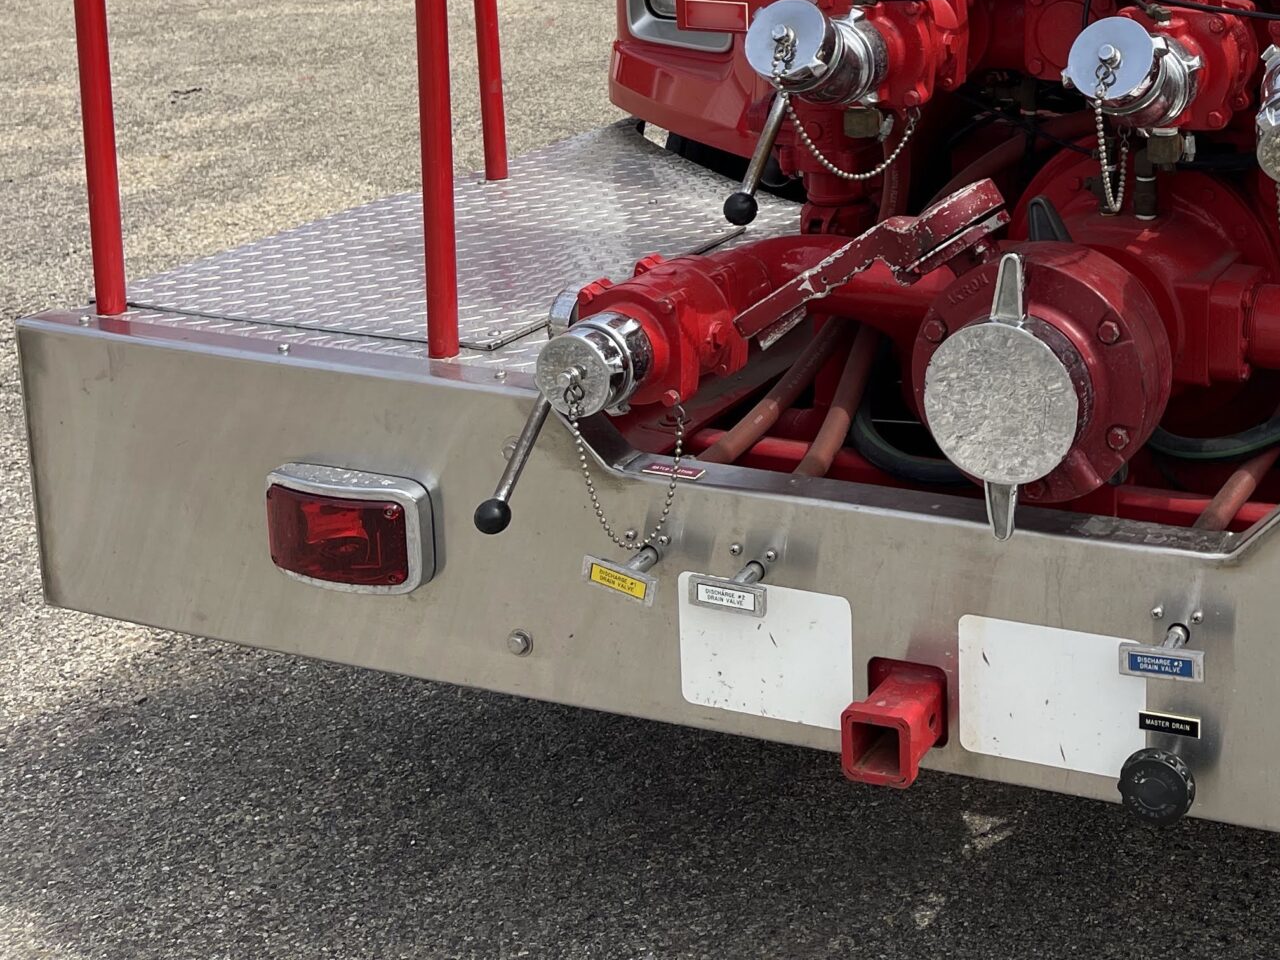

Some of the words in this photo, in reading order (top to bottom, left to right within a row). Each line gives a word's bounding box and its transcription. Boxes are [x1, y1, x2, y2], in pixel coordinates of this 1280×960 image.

[599, 568, 629, 585] DISCHARGE
[600, 575, 616, 585] DRAIN
[617, 582, 635, 593] VALVE
[705, 588, 736, 599] DISCHARGE
[707, 594, 724, 603] DRAIN
[726, 598, 744, 606] VALVE
[1137, 656, 1171, 667] DISCHARGE
[1139, 662, 1159, 671] DRAIN
[1161, 665, 1181, 674] VALVE
[1145, 718, 1170, 728] MASTER
[1172, 723, 1190, 732] DRAIN
